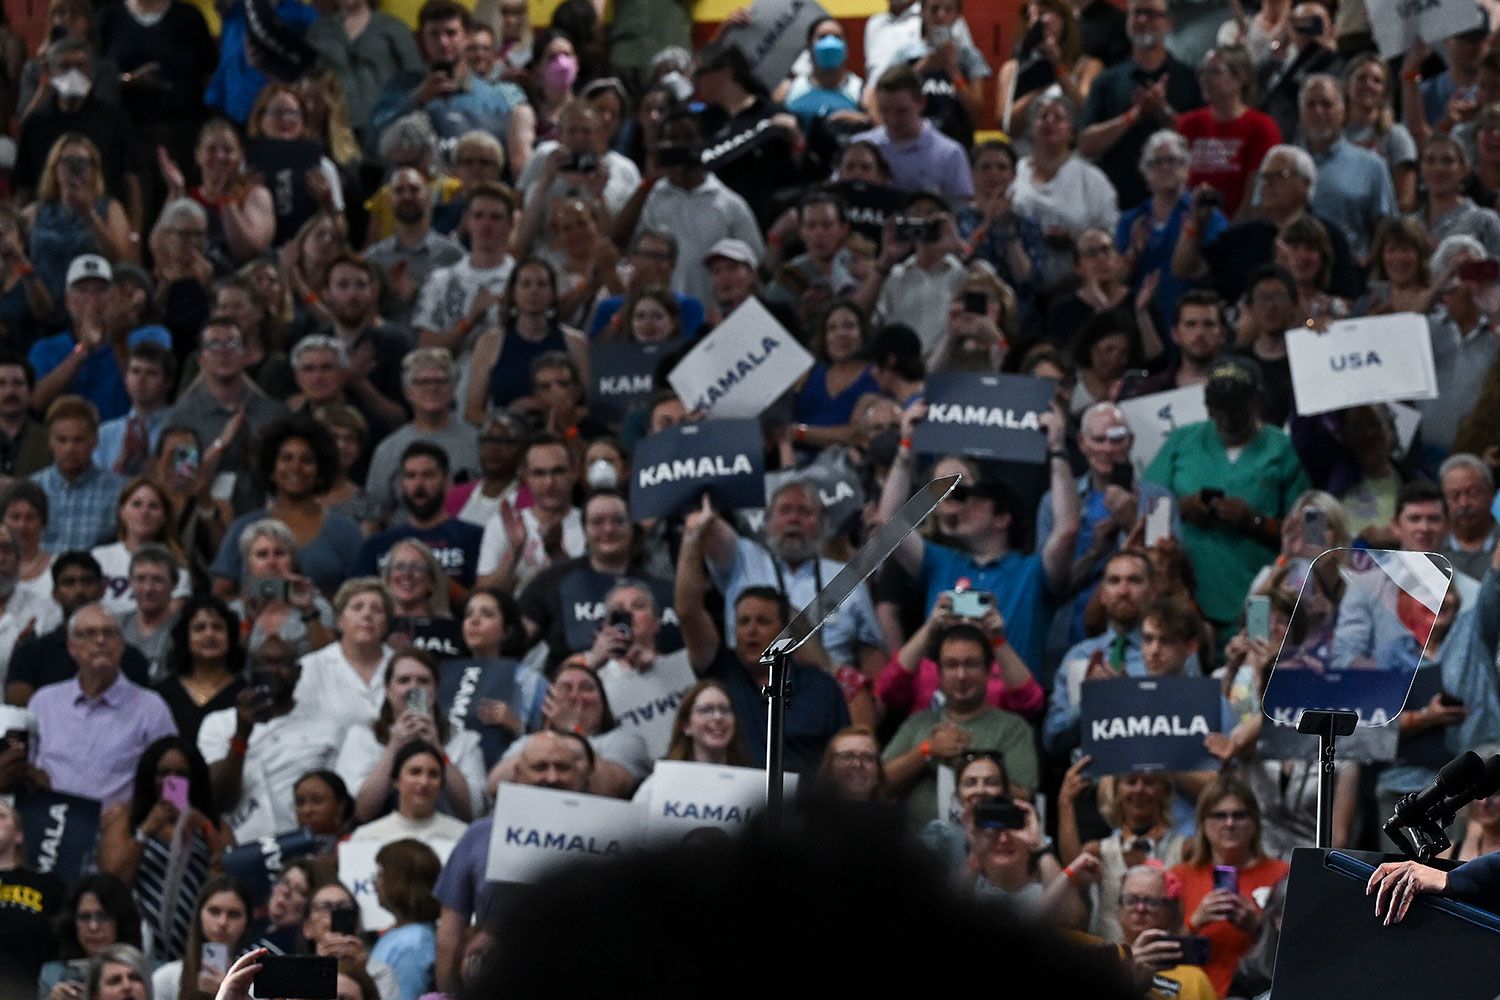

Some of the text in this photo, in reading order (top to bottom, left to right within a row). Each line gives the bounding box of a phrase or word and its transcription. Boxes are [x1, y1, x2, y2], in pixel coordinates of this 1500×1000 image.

[1329, 351, 1382, 371] USA
[600, 374, 655, 396] KAM
[927, 402, 1039, 431] KAMALA
[638, 453, 754, 488] KAMALA
[1091, 714, 1211, 741] KAMALA
[36, 802, 70, 874] MALA
